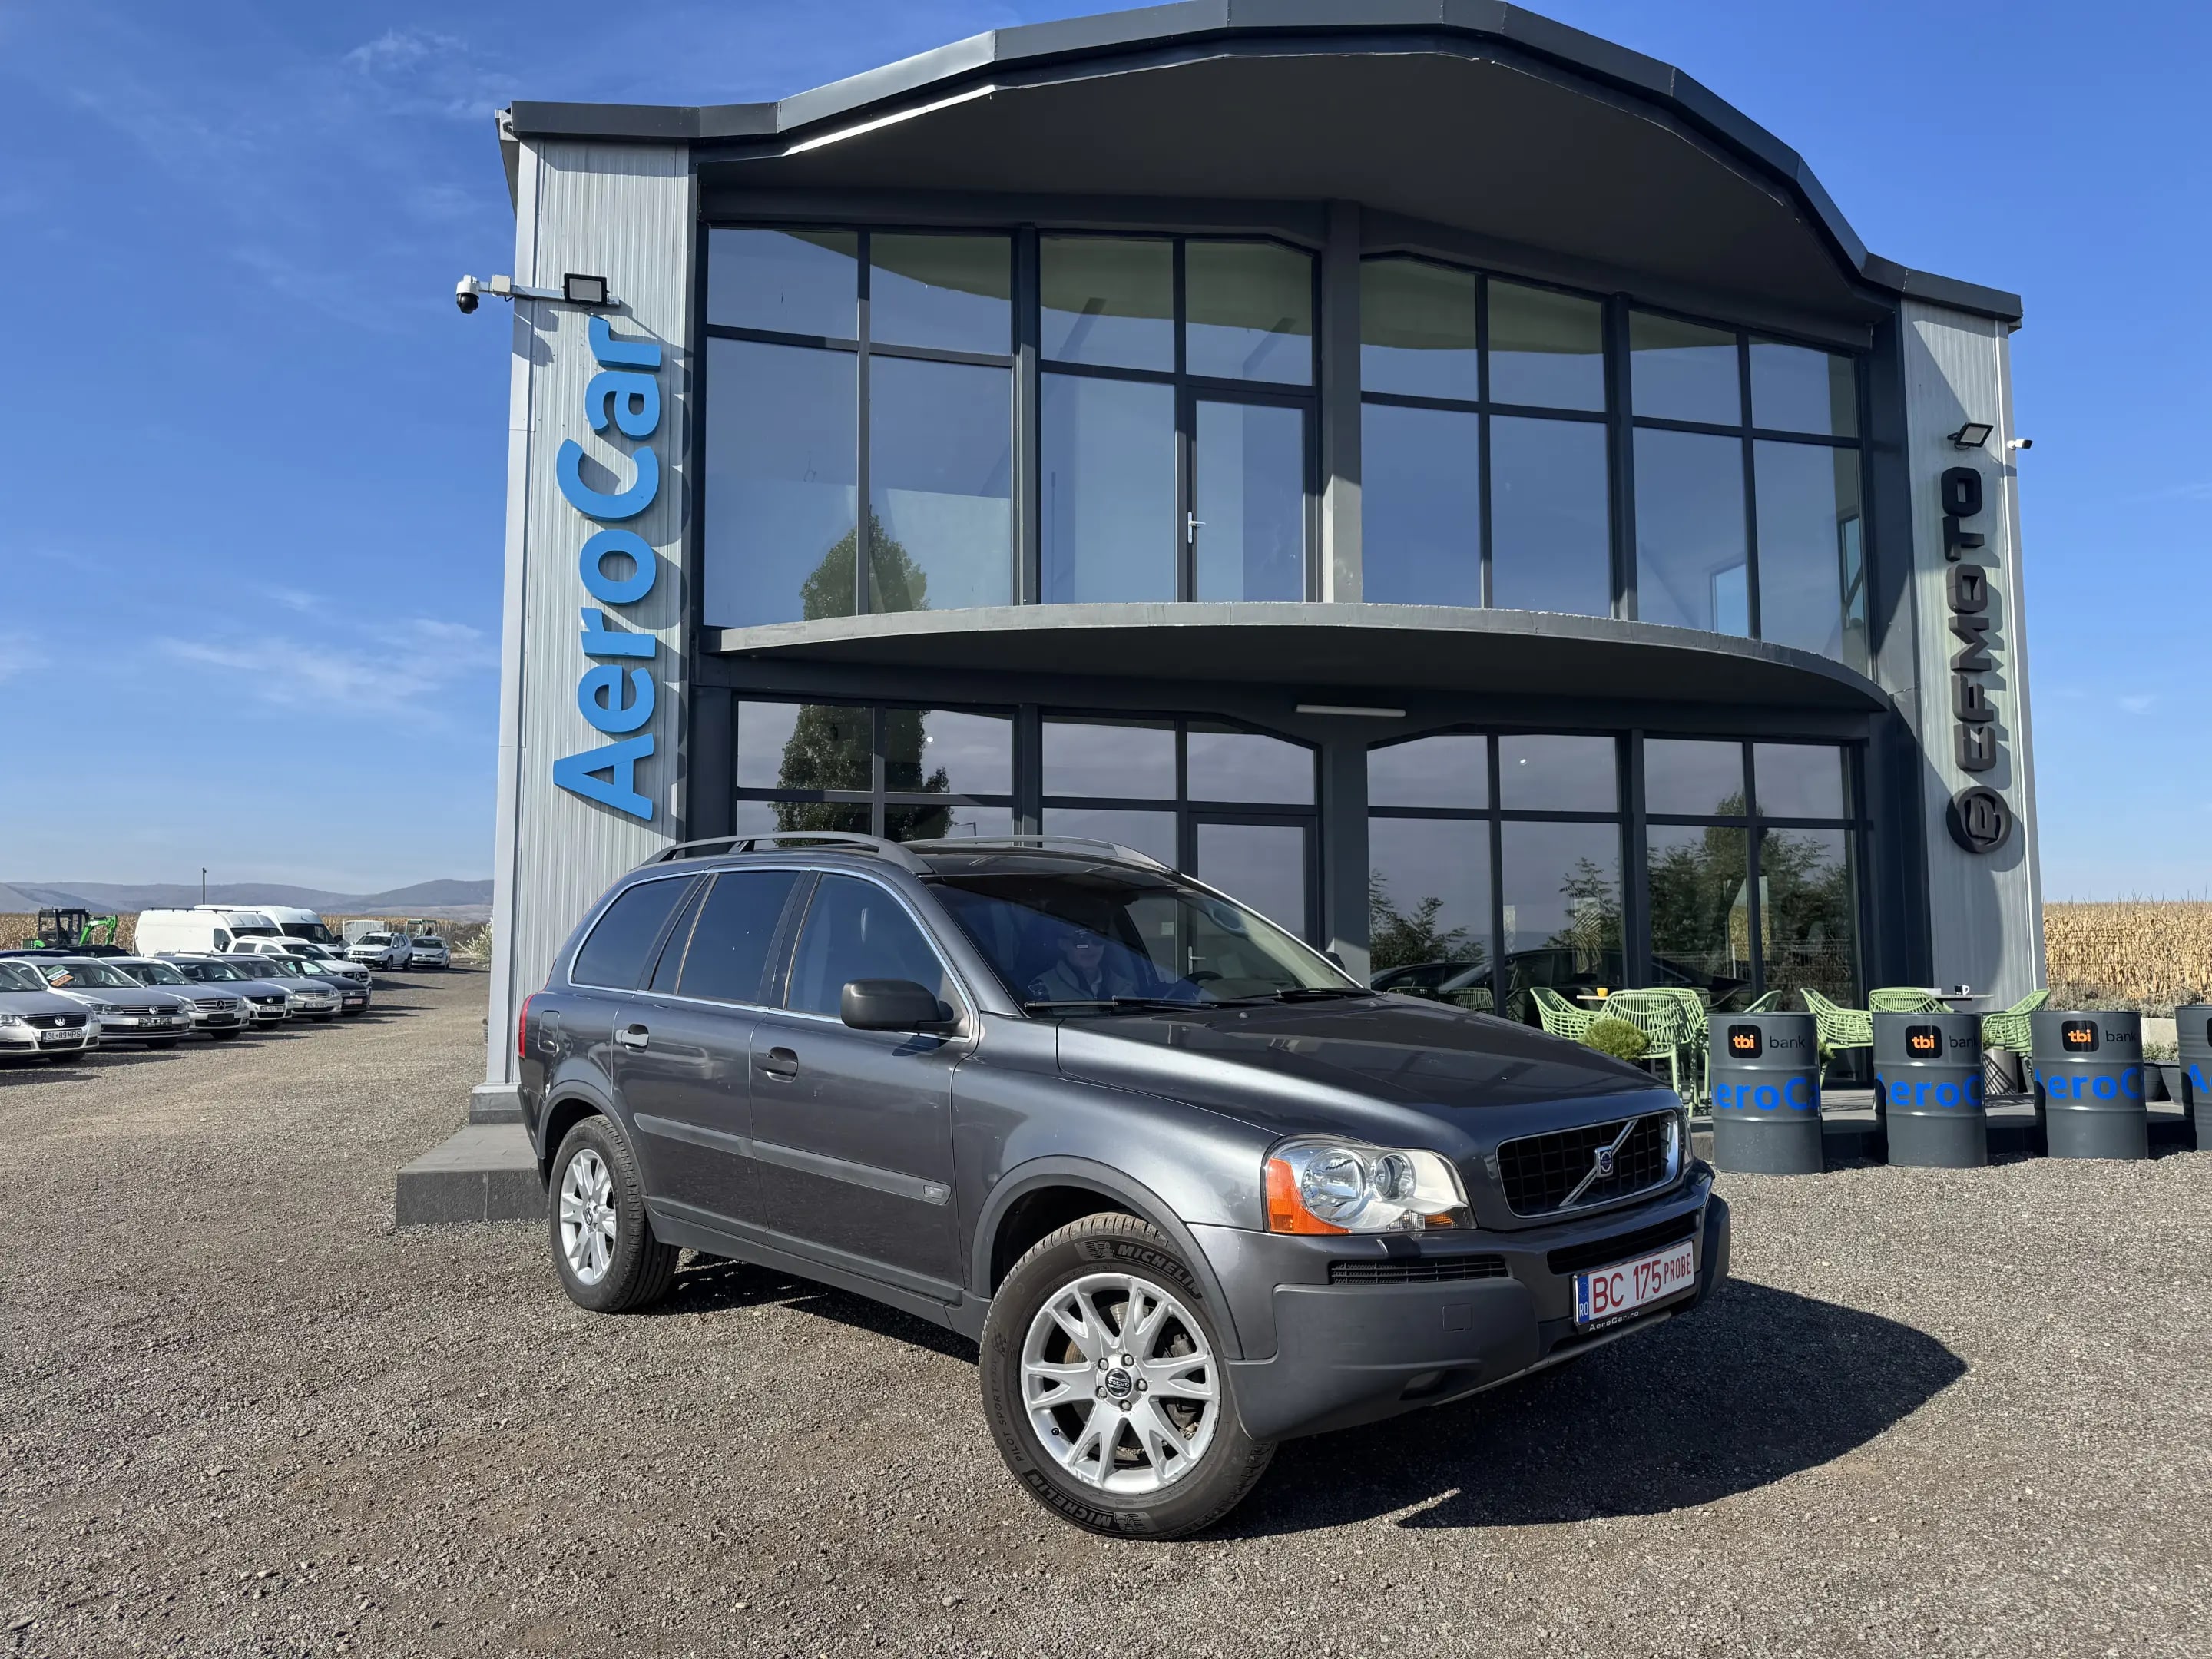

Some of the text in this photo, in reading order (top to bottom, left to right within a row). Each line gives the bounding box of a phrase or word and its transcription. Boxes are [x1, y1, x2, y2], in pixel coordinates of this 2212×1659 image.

[552, 314, 662, 821] AeroCar
[1941, 466, 1998, 771] CFMOTO
[1732, 1035, 1806, 1049] tbi bank
[1911, 1035, 1936, 1049] tbi
[2068, 1028, 2137, 1043] tbi bank
[1710, 1077, 1819, 1111] eroC
[2188, 1063, 2212, 1094] A
[1117, 1244, 1200, 1296] MICHELIN
[1578, 1253, 1691, 1317] RO BC 175 PROBE
[1589, 1311, 1638, 1331] AeroCar.ro
[992, 1386, 1007, 1426] SPORT
[1002, 1431, 1025, 1462] PILOT
[1027, 1472, 1112, 1528] MICHELIN
